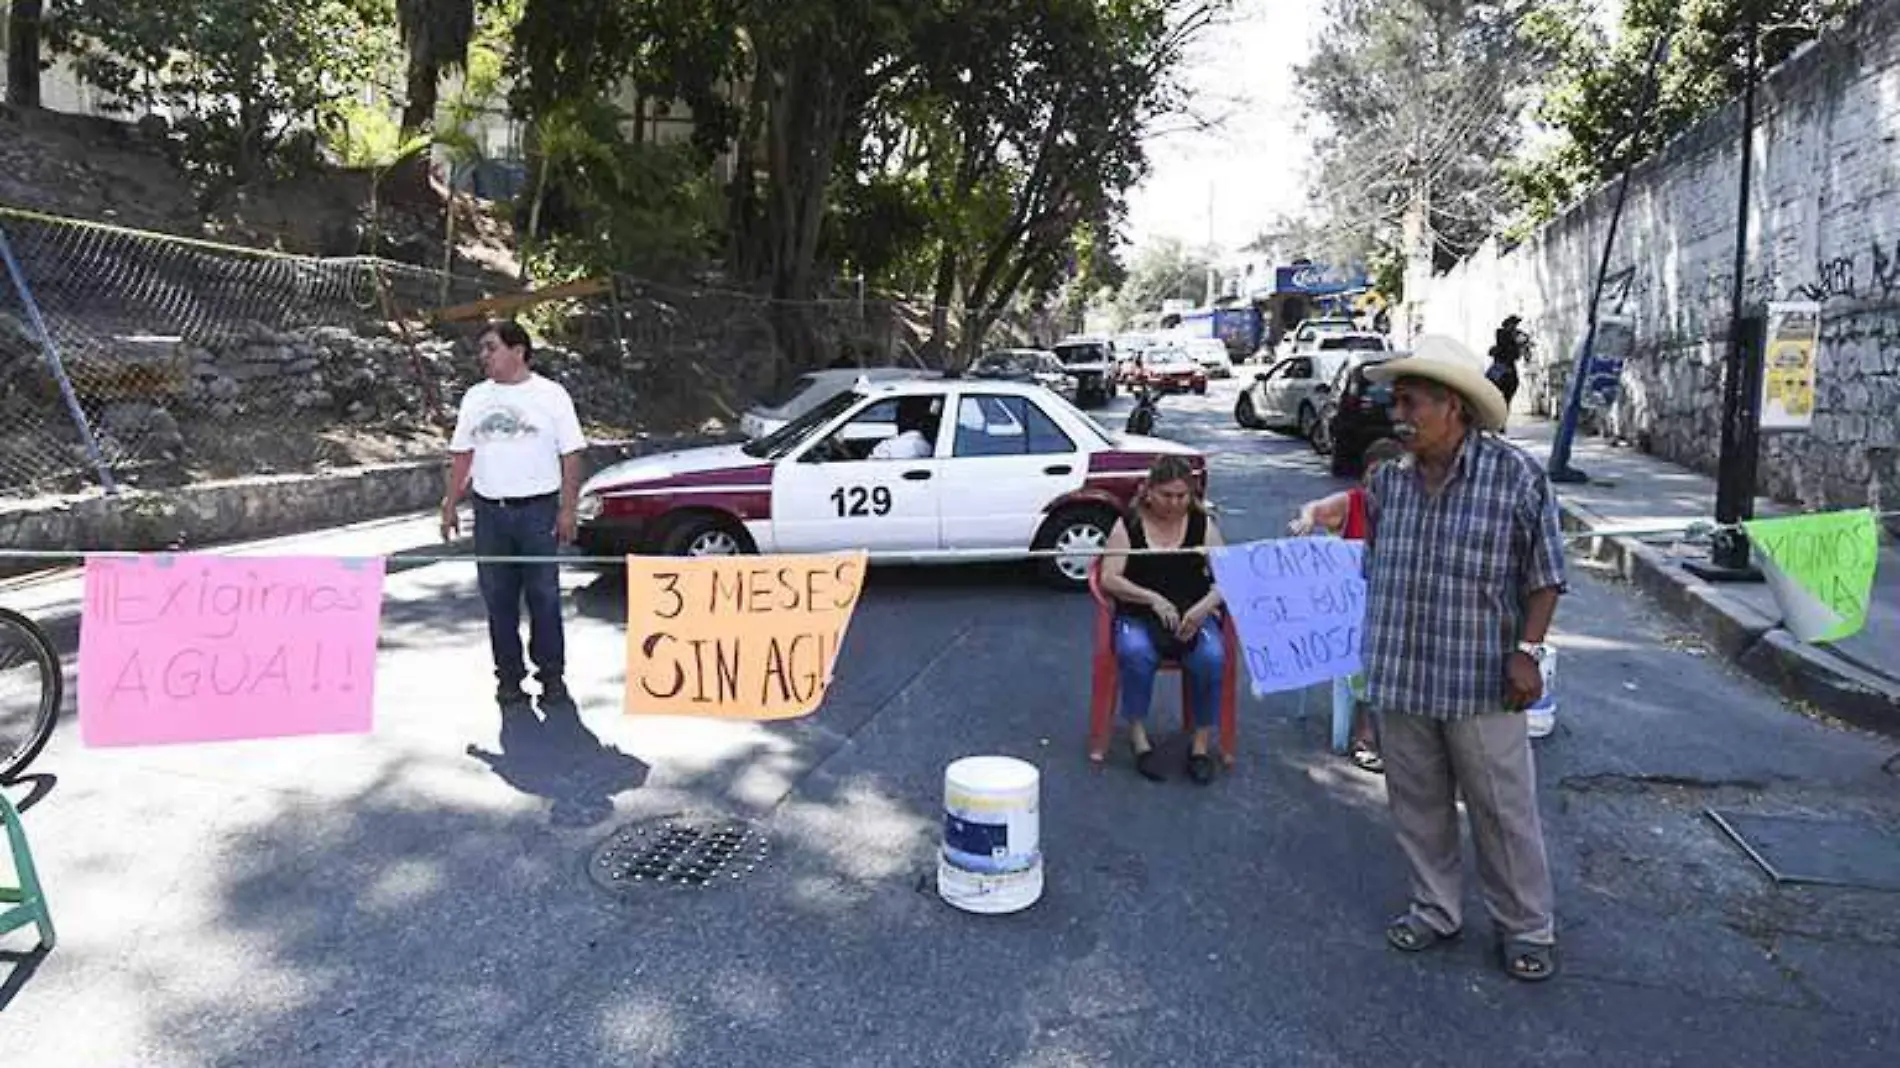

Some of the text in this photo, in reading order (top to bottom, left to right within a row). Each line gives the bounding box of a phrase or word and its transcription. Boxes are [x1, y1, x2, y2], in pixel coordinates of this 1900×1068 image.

[830, 486, 892, 517] 129
[652, 560, 859, 619] 3 MESES
[640, 631, 741, 706] SIN
